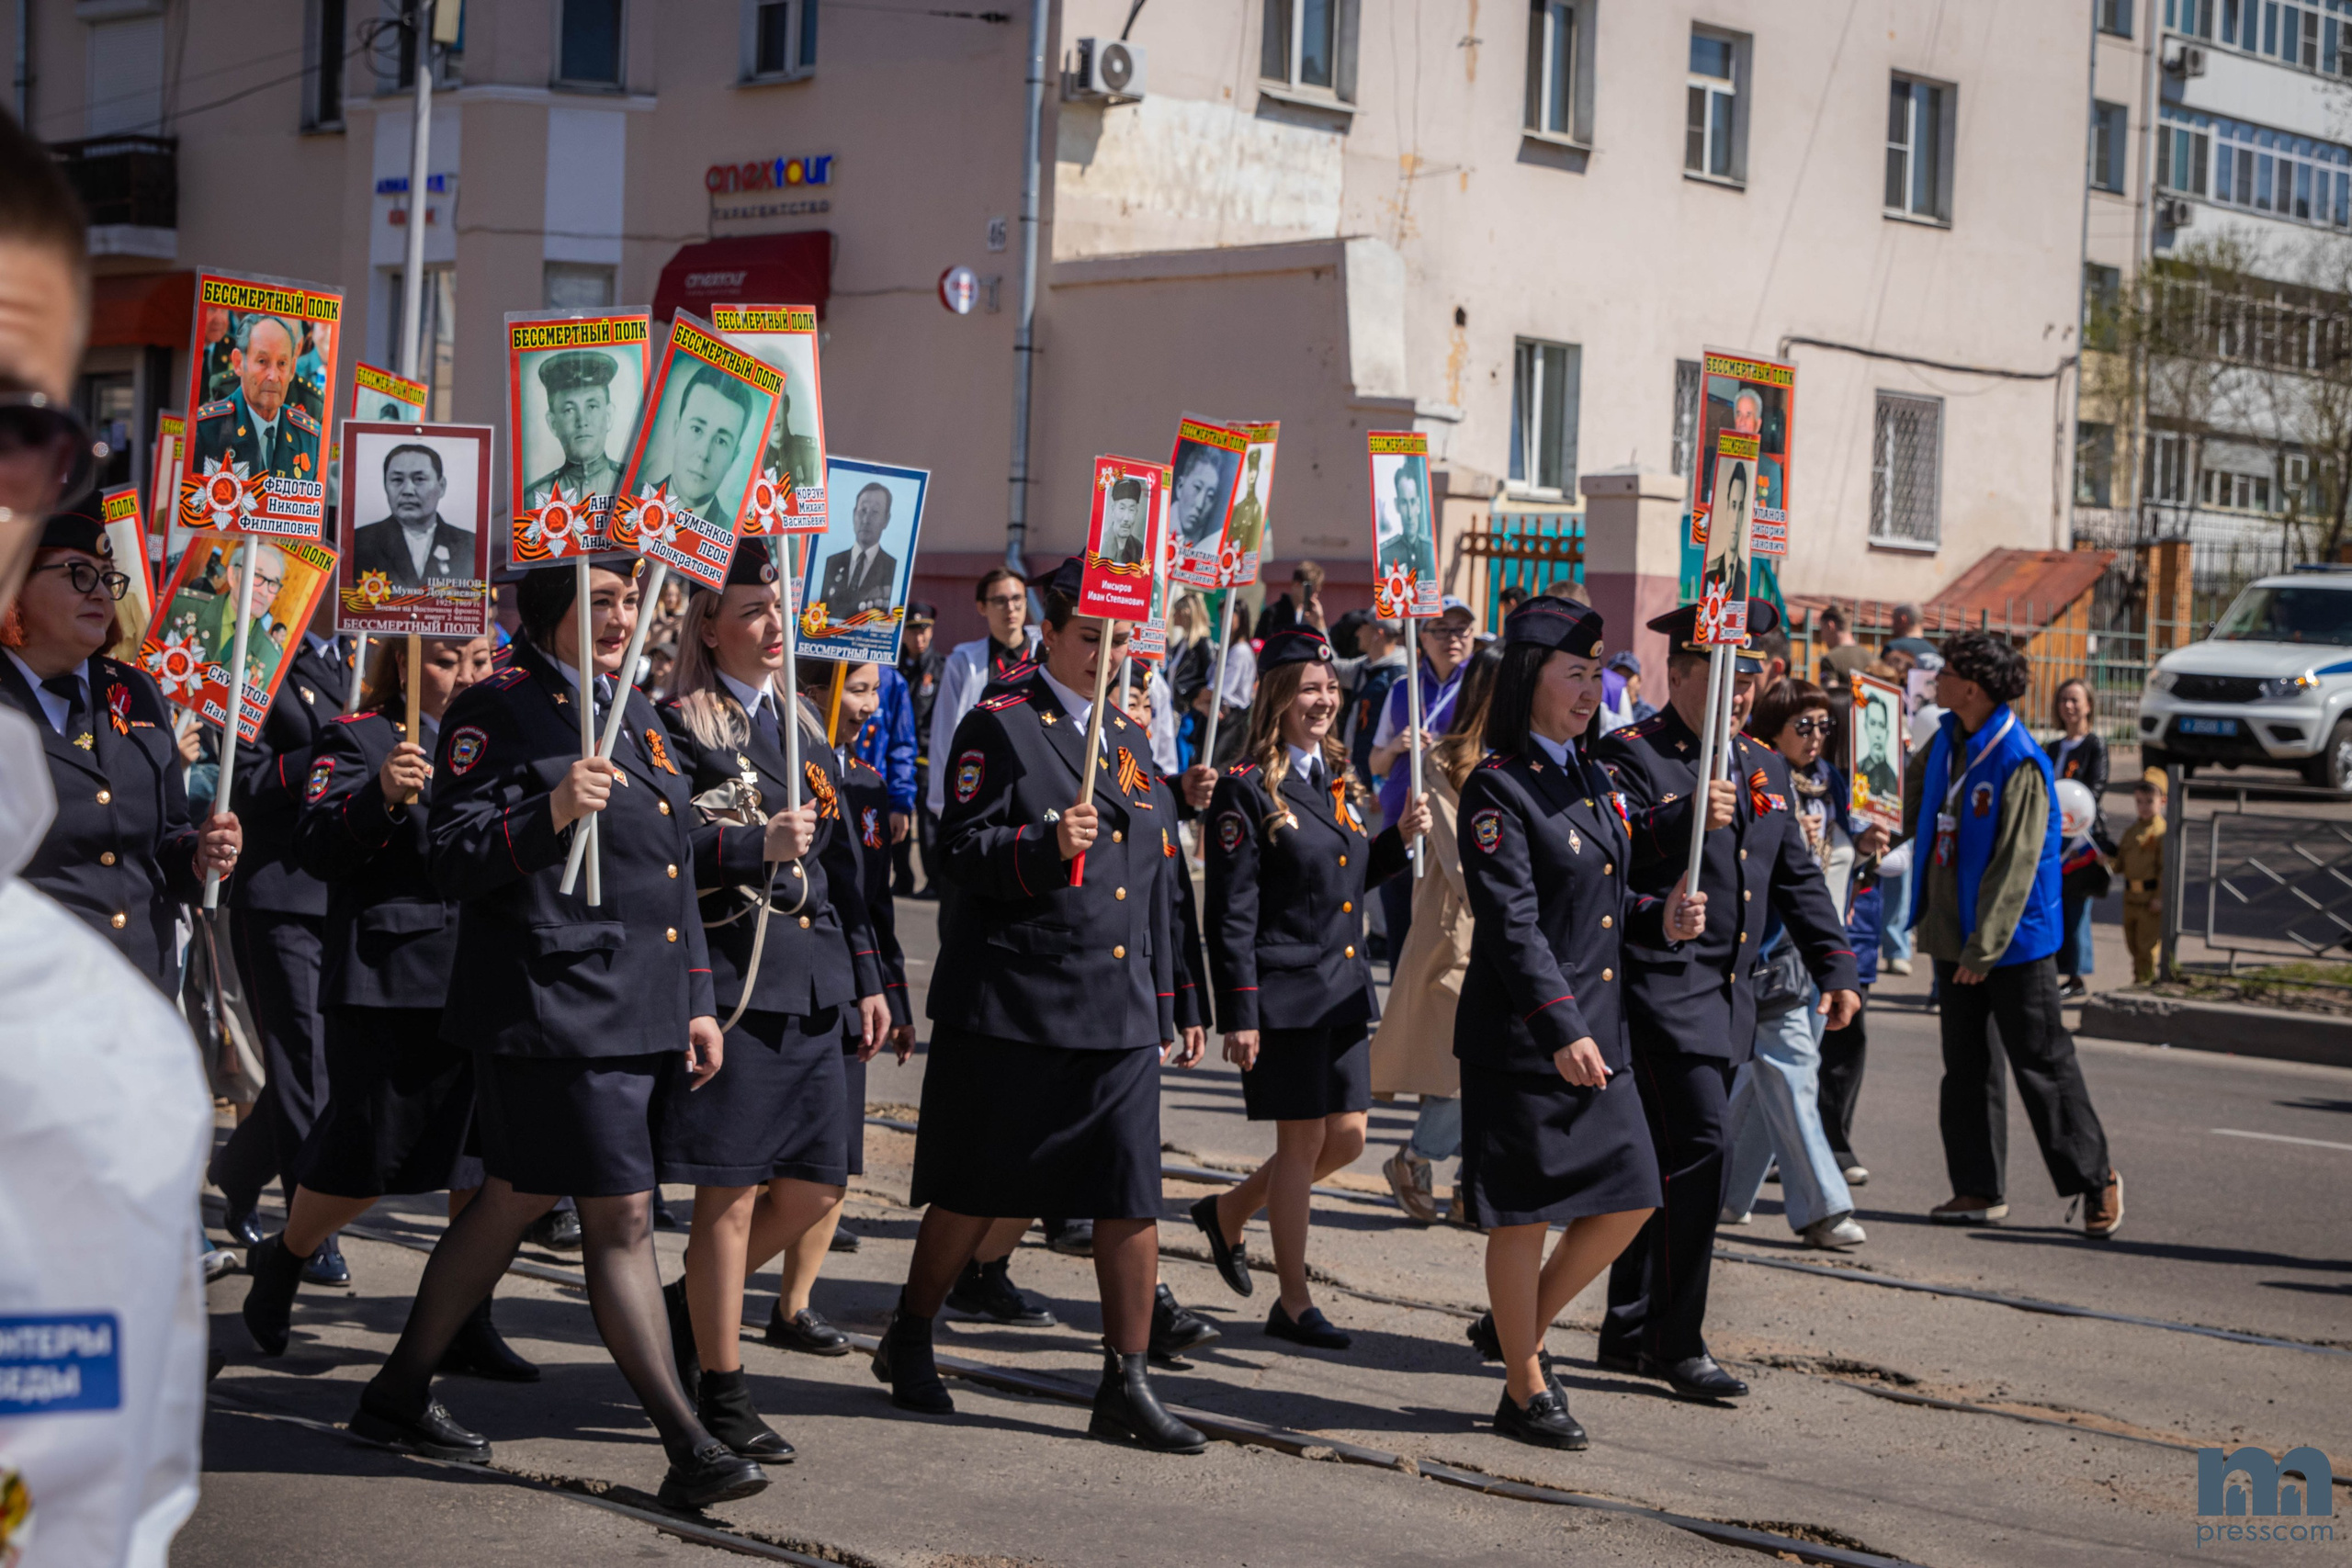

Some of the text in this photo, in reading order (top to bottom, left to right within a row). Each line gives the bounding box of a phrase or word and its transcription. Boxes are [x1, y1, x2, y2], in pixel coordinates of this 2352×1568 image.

[706, 155, 835, 193] anextour
[204, 281, 339, 320] БЕССМЕРТНЫЙ ПОЛК
[716, 310, 816, 330] БЕССМЕРТНЫЙ ПОЛК
[513, 321, 648, 348] БЕССМЕРТНЫЙ ПОЛК
[673, 324, 784, 395] БЕССМЕРТНЫЙ ПОЛК
[1706, 357, 1794, 386] БЕССМЕРТНЫЙ ПОЛК
[264, 479, 322, 496] ФЕДОТОВ
[797, 488, 825, 499] КОРЗУН
[109, 496, 137, 517] ПОЛК
[268, 498, 320, 516] Николай
[798, 502, 825, 513] Михаил
[240, 515, 318, 536] Филлипович
[675, 511, 734, 547] СУМЕНКОВ
[783, 515, 827, 527] Васильевич
[300, 544, 334, 571] ПОЛК
[651, 540, 722, 581] Понкратович
[698, 541, 729, 564] ЛЕОН
[391, 585, 481, 598] Мунко Доржиевич
[427, 577, 481, 589] ЦЫРЕНОВ
[1102, 580, 1132, 593] Имсыров
[1088, 591, 1144, 606] Иван Степанович
[413, 605, 452, 615] Восточном
[454, 607, 482, 616] фронте,
[344, 618, 480, 634] БЕССМЕРТНЫЙ ПОЛК
[797, 642, 868, 660] БЕССМЕРТНЫЙ
[869, 650, 894, 662] ПОЛК
[209, 666, 270, 706] СКУАТОВ
[238, 701, 263, 722] ван
